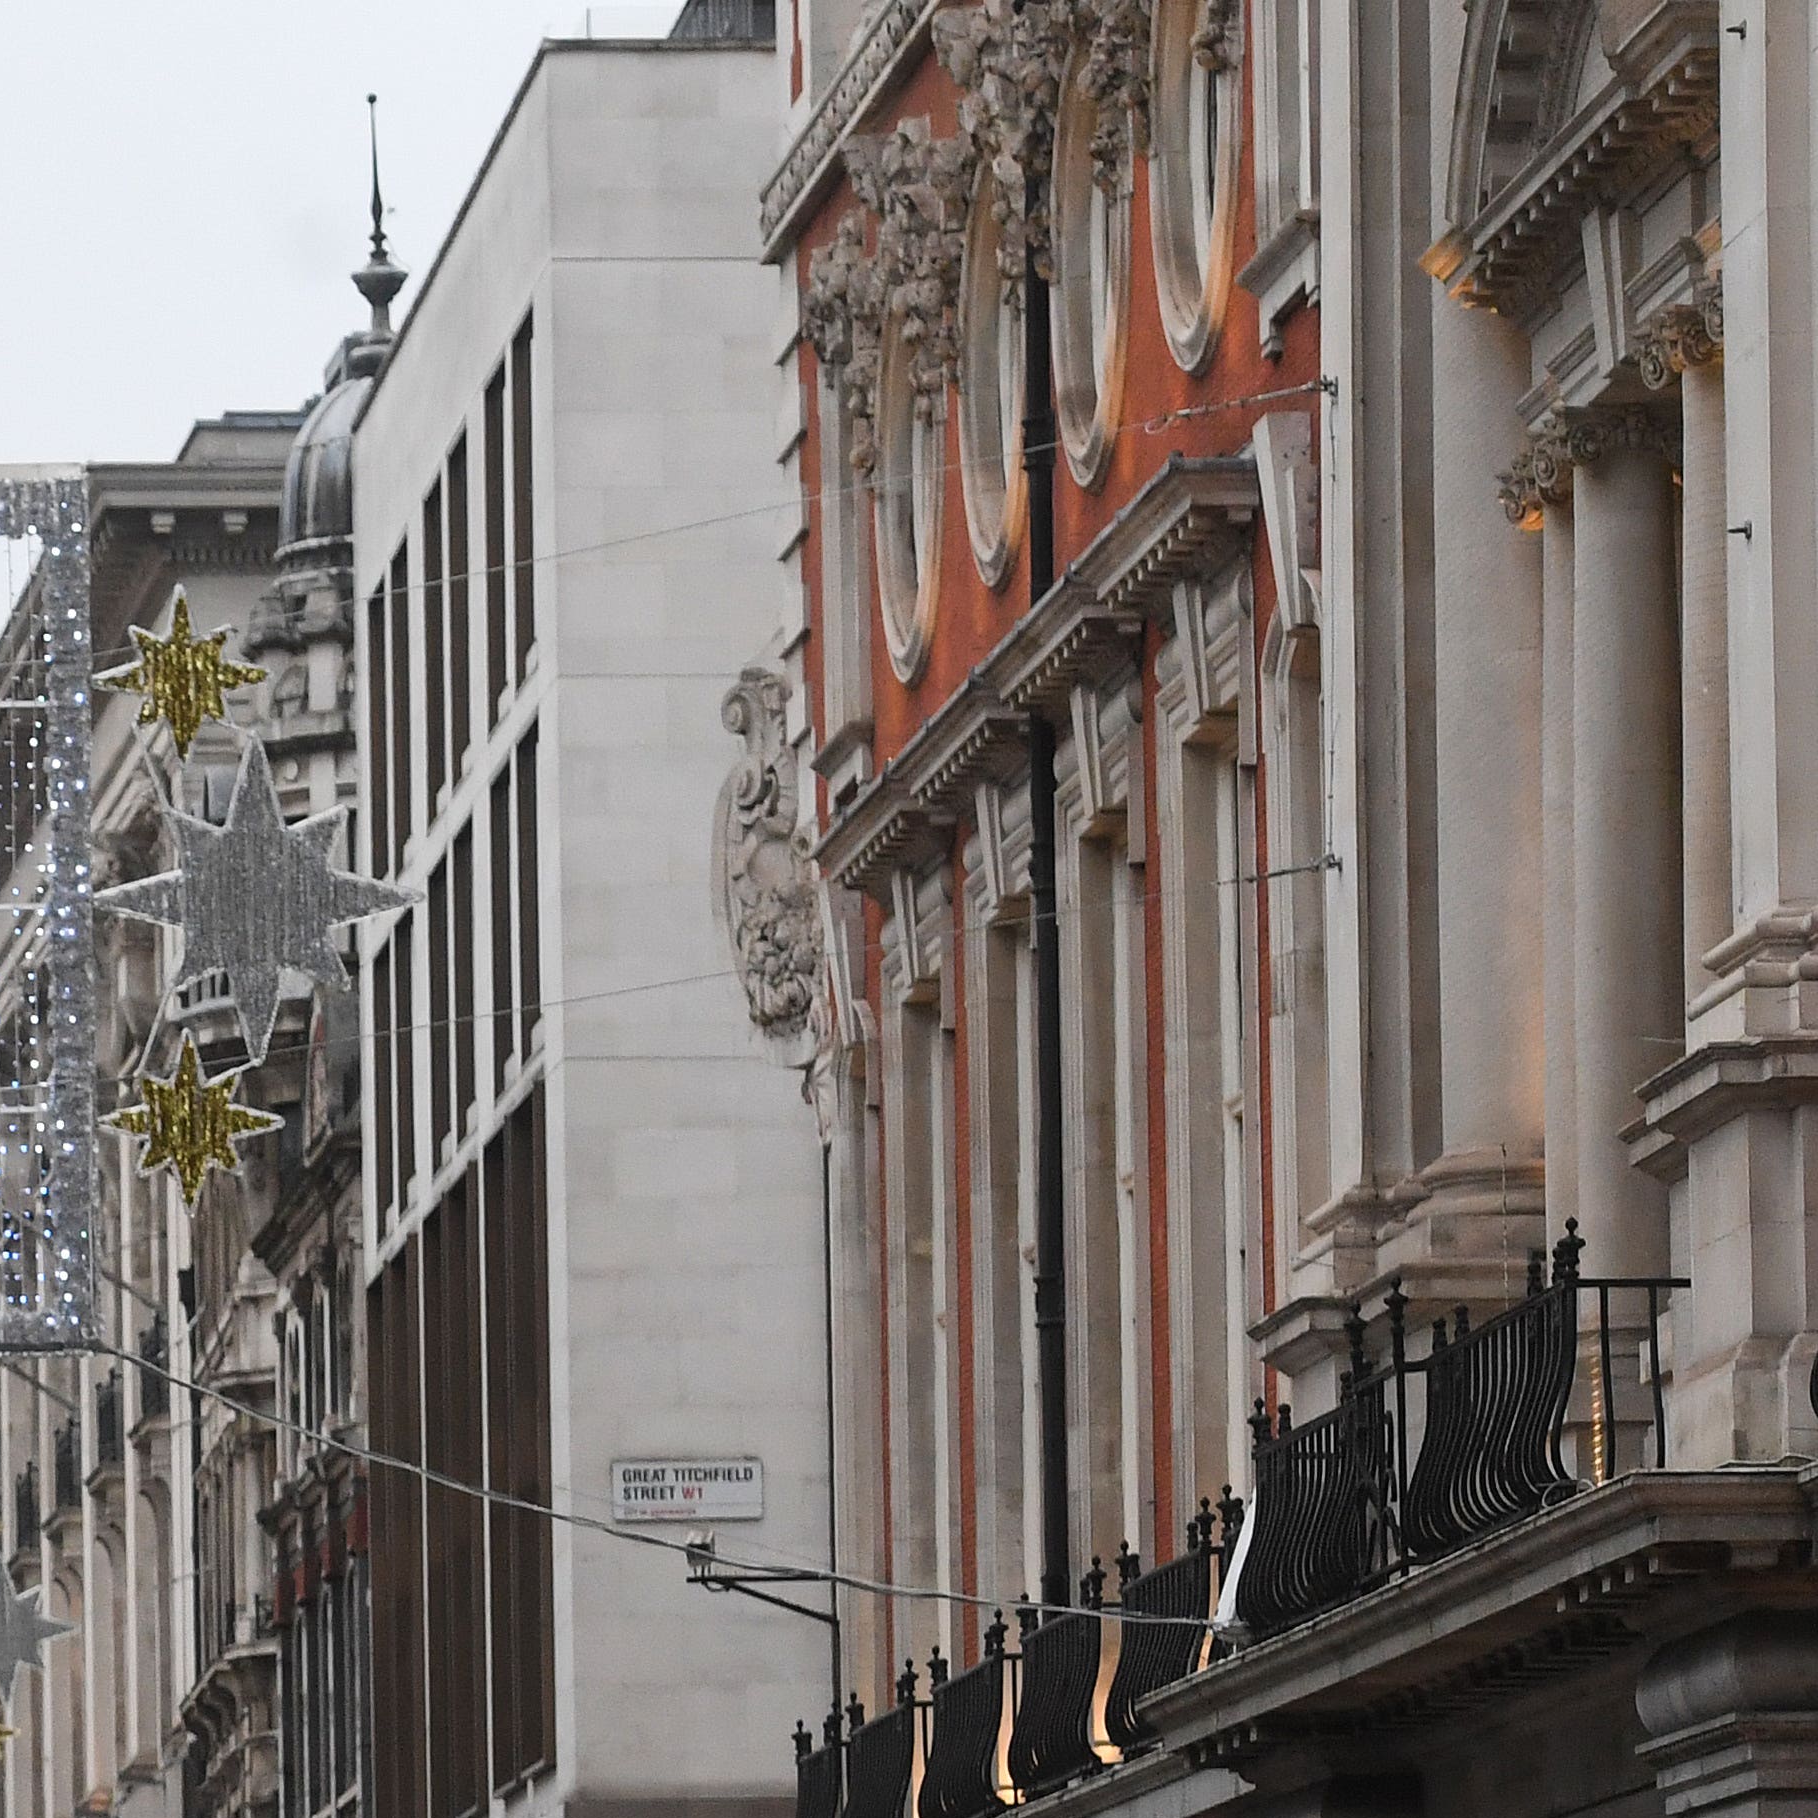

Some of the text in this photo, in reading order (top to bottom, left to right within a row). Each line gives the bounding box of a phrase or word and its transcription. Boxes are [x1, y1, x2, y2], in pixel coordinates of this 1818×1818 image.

[622, 1466, 753, 1484] GREAT TITCHFIELD
[623, 1486, 703, 1501] STREET W1
